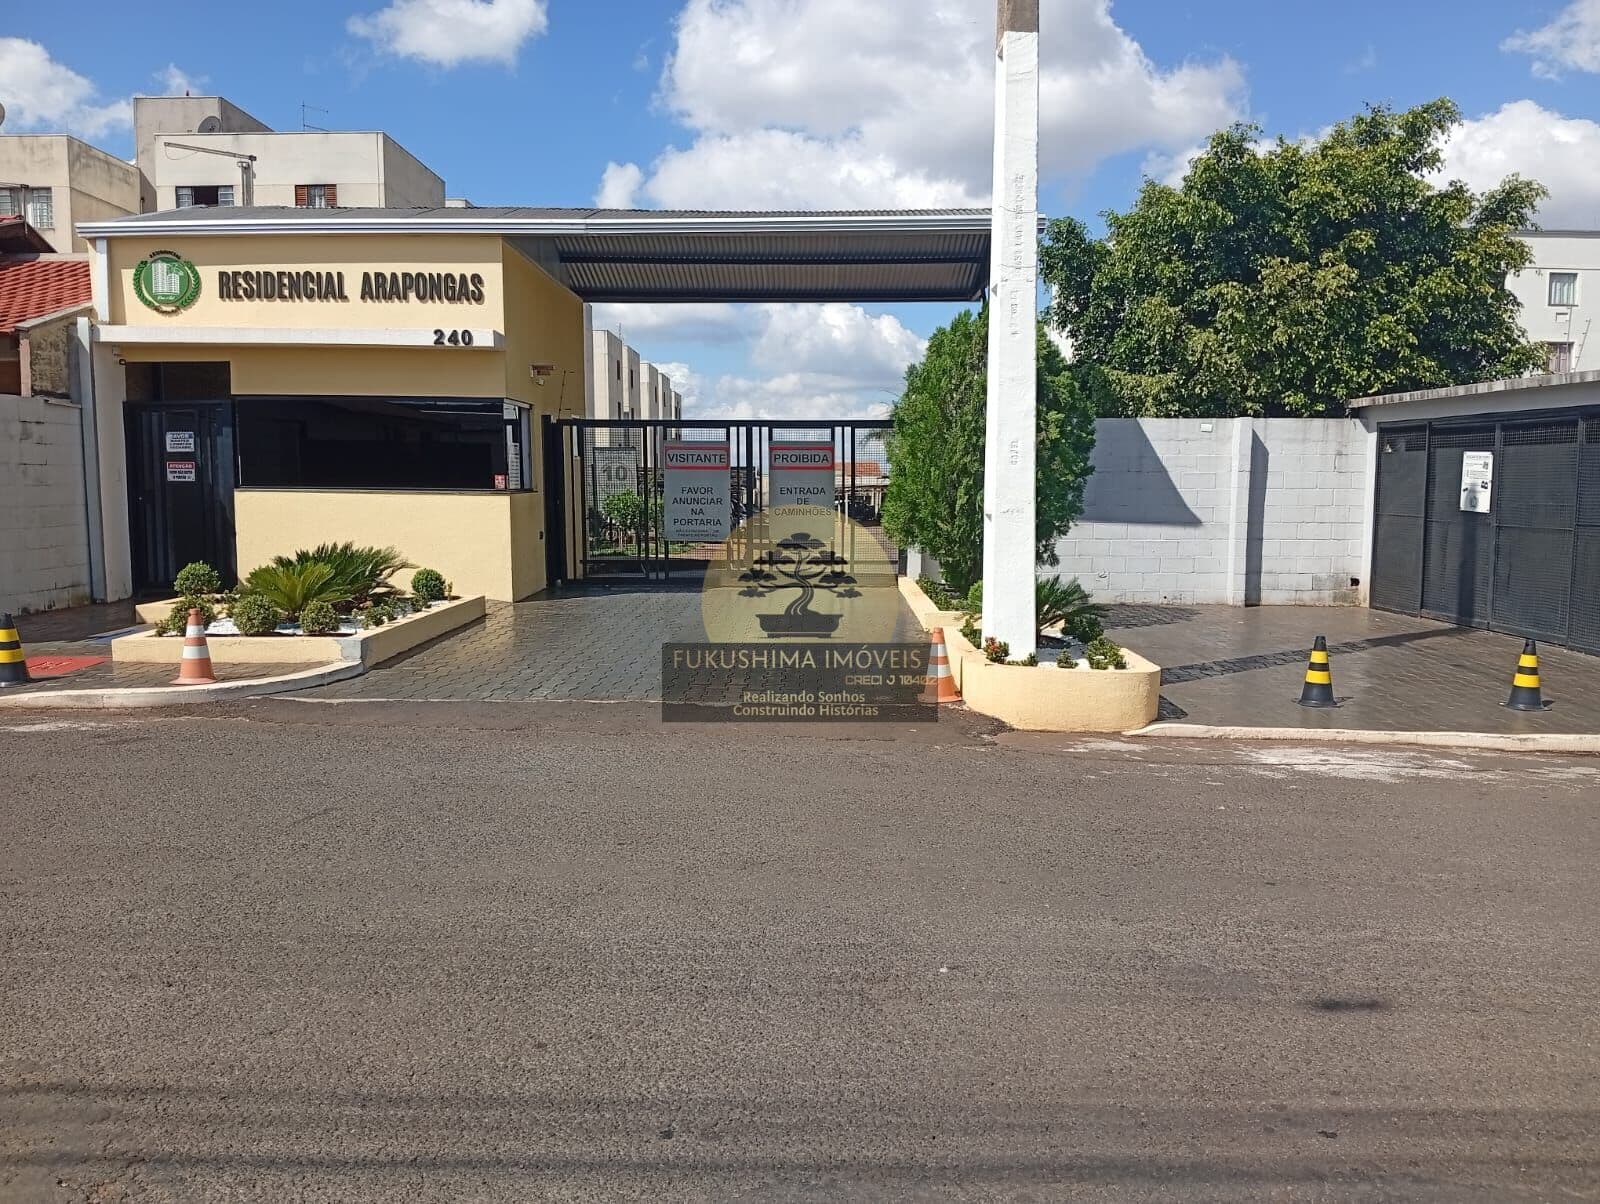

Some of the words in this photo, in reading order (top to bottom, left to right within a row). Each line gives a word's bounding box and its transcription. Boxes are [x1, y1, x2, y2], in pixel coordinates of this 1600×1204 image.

[218, 270, 349, 301] RESIDENCIAL
[360, 271, 485, 304] ARAPONGAS
[433, 329, 474, 346] 240
[667, 453, 727, 464] VISITANTE
[773, 453, 830, 464] PROIBIDA
[681, 487, 714, 495] FAVOR
[779, 487, 826, 495] ENTRADA
[672, 497, 723, 505] ANUNCIAR
[796, 497, 809, 505] DE
[690, 508, 705, 516] NA
[774, 506, 832, 516] CAMINHÕES
[673, 518, 722, 526] PORTARIA
